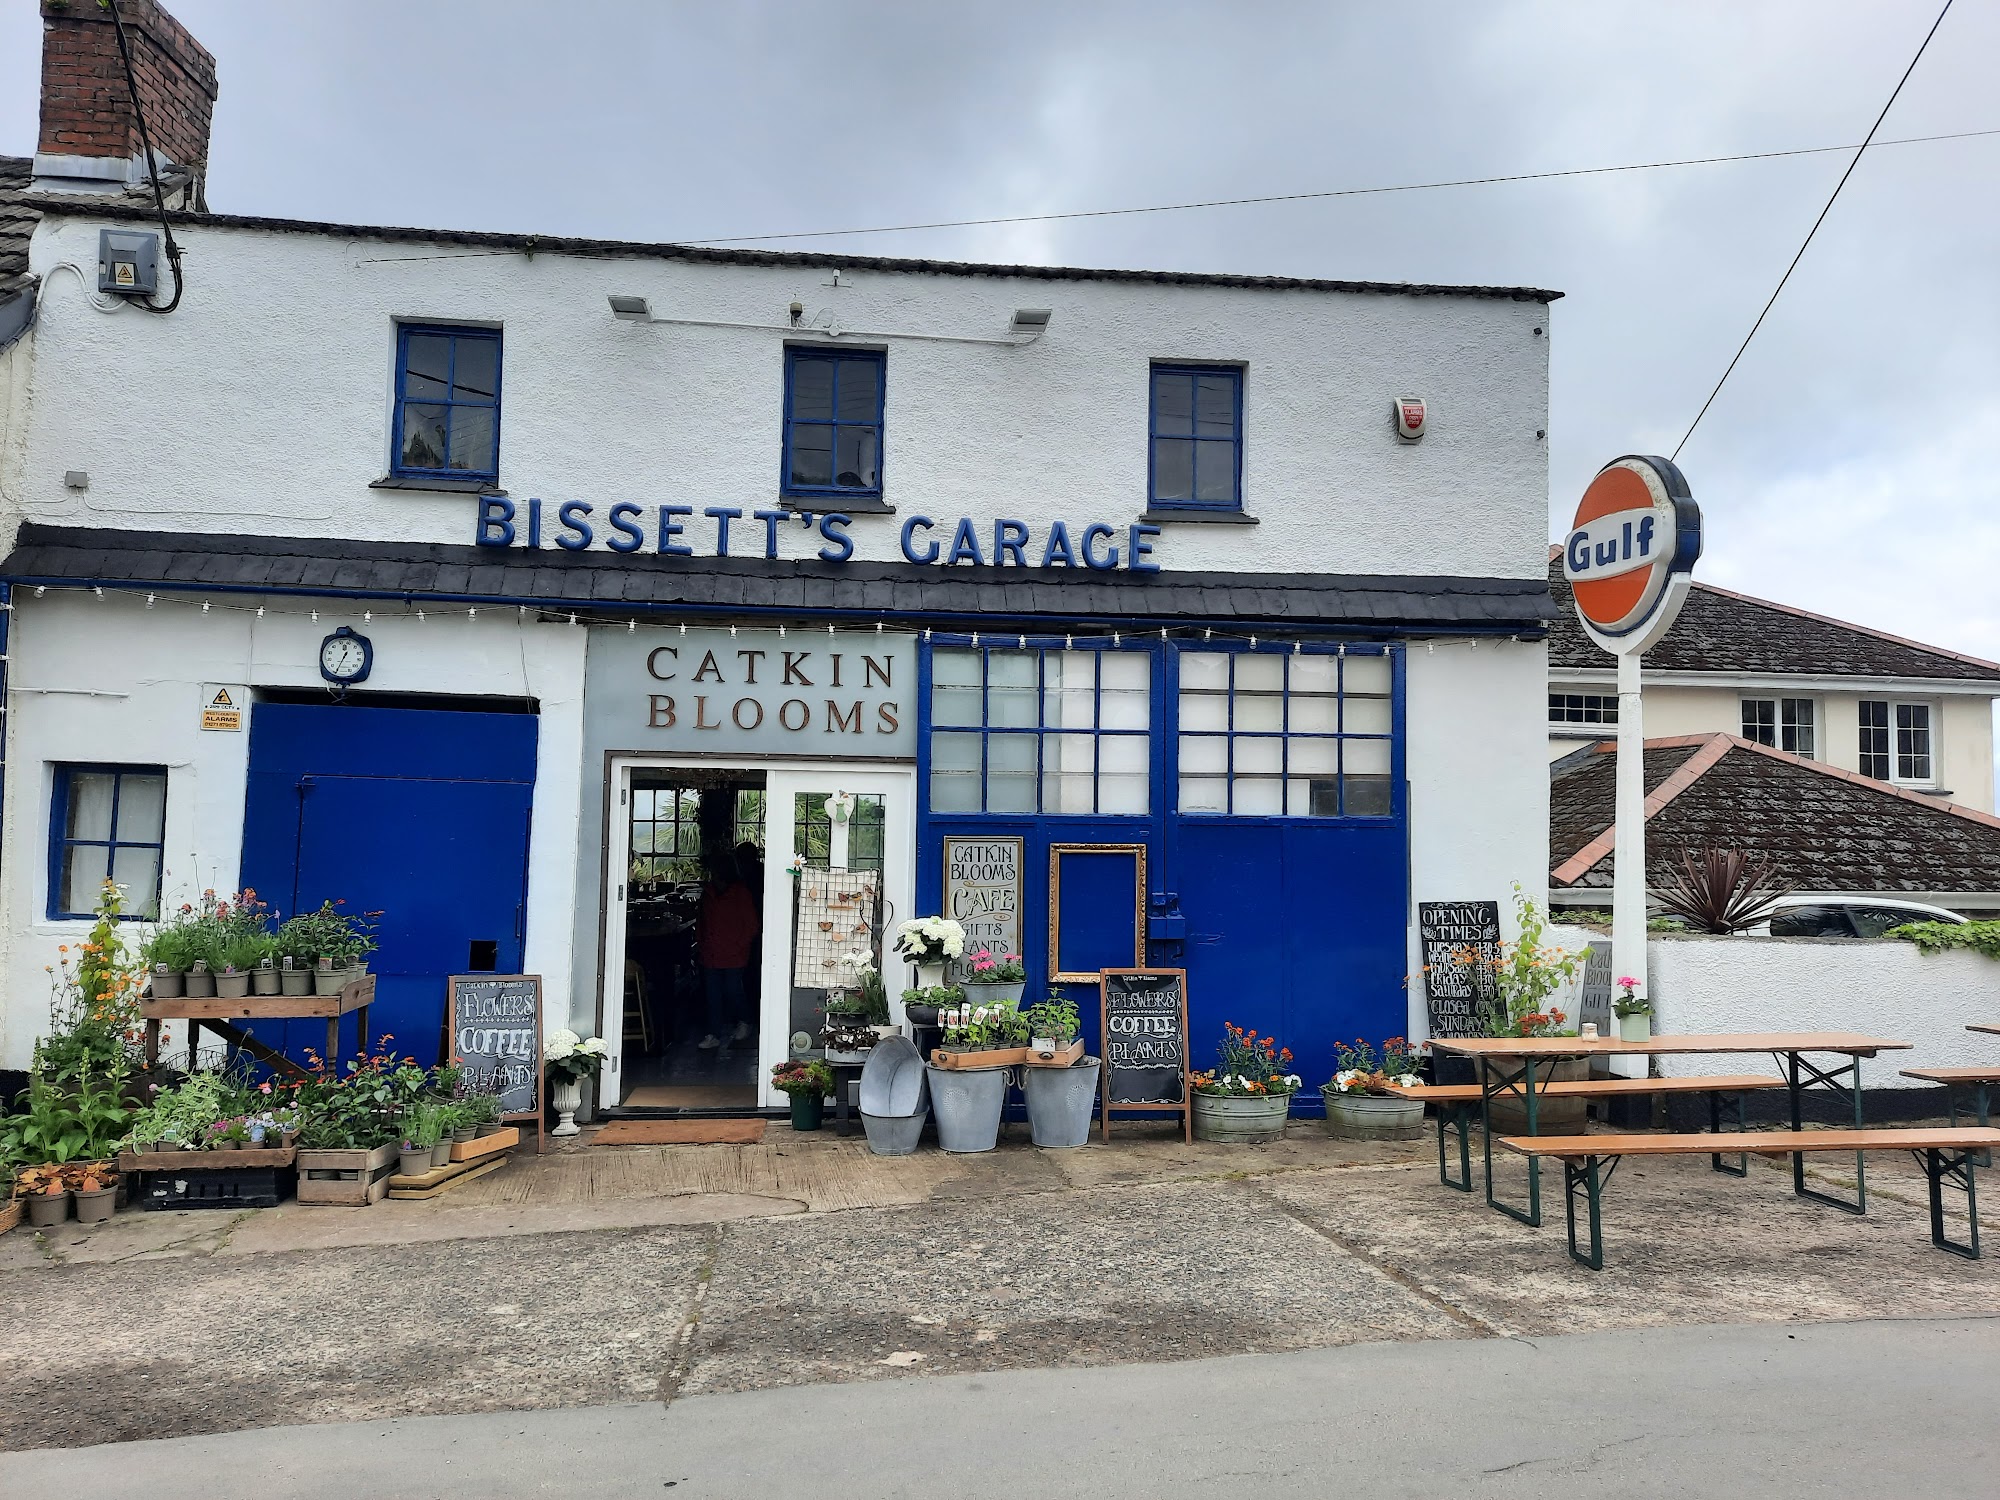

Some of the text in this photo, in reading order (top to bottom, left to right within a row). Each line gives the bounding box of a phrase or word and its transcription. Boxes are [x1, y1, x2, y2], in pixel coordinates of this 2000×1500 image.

[475, 496, 1162, 573] BISSETT'S GARAGE
[1568, 516, 1654, 573] Gulf
[646, 646, 895, 688] CATKIN
[647, 694, 900, 735] BLOOMS
[954, 844, 1012, 863] CATKIN
[951, 863, 1016, 881] BLOOMS
[950, 887, 1015, 920] CAFE
[1422, 906, 1491, 925] OPENING
[961, 923, 1003, 936] GIFTS
[1436, 925, 1482, 940] TIMES
[962, 939, 1009, 955] LANTS
[463, 993, 533, 1018] FLOWERS
[1110, 990, 1177, 1008] FLOWERS
[1109, 1016, 1177, 1034] COFFEE
[460, 1026, 532, 1056] COFFEE
[1110, 1040, 1177, 1061] PLANTS
[460, 1064, 531, 1086] PLANTS
